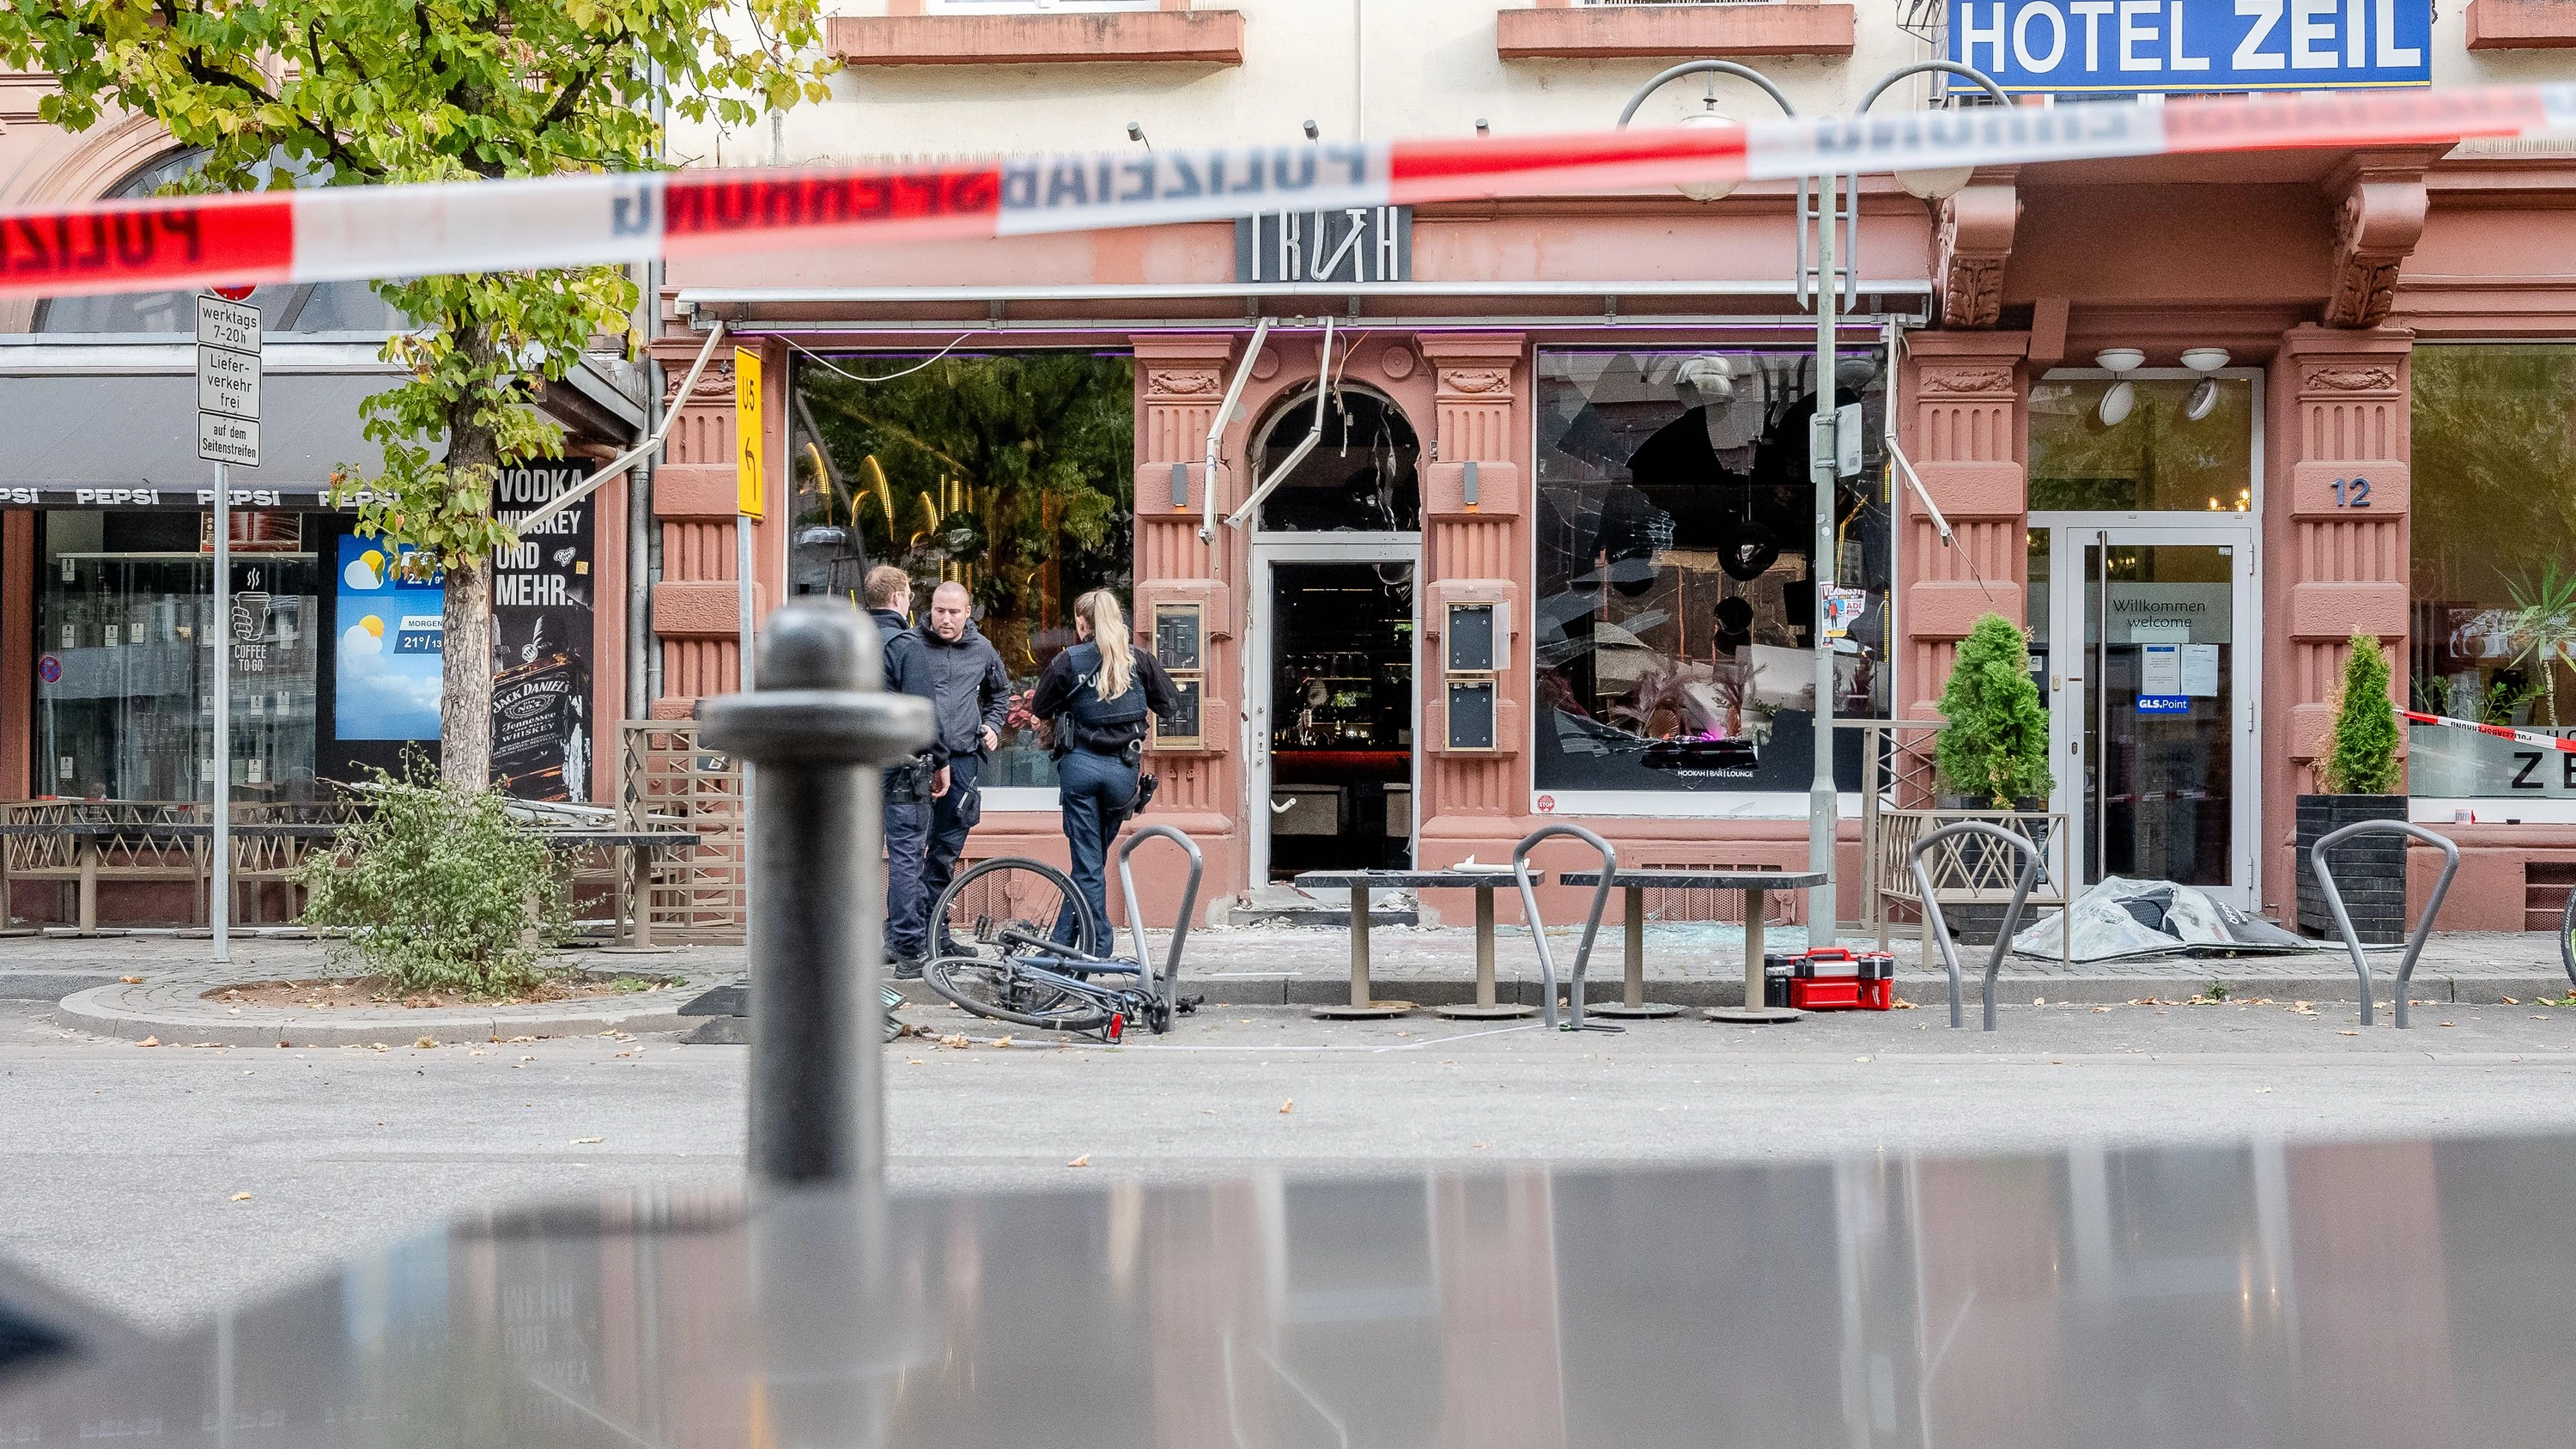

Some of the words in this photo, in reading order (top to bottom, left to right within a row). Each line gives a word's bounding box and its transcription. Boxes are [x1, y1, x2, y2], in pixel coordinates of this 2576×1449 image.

[1961, 0, 2209, 73] HOTEL
[2232, 0, 2421, 70] ZEIL
[1247, 206, 1399, 283] TRUTH
[203, 307, 257, 330] werktags
[210, 353, 250, 372] Liefer-
[207, 374, 252, 393] verkehr
[742, 376, 755, 411] U5
[221, 393, 240, 410] frei
[214, 424, 226, 436] auf
[230, 426, 246, 440] dem
[203, 438, 257, 459] Seitenstreifen
[498, 469, 586, 502] VODKA
[2330, 477, 2372, 507] 12
[76, 488, 161, 505] PEPSI
[496, 542, 540, 569] UND
[496, 574, 574, 606] MEHR.
[2112, 599, 2206, 613] Willkommen
[2127, 615, 2192, 628] welcome
[234, 645, 267, 659] COFFEE
[239, 659, 249, 671] TO
[252, 659, 264, 672] GO
[492, 689, 522, 714] JACK
[2139, 699, 2187, 709] GLS.Point
[502, 712, 556, 732] Tennessee
[502, 722, 555, 742] WHISKEY
